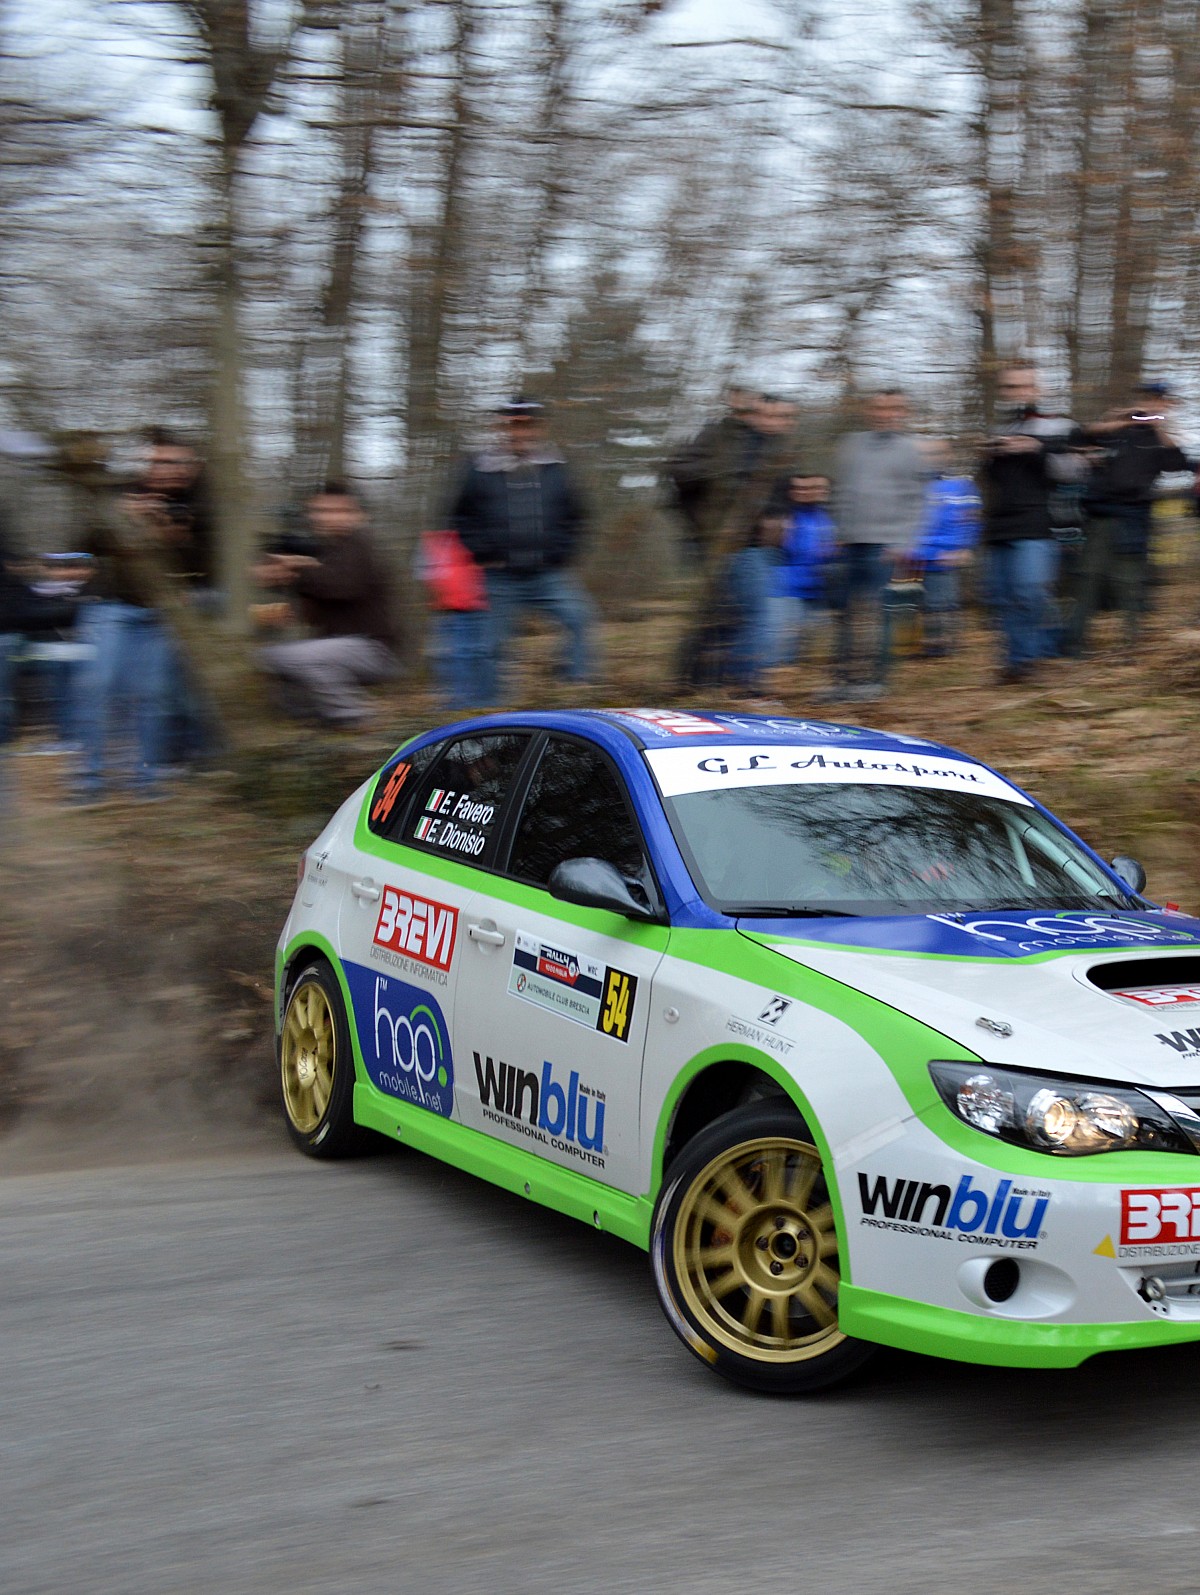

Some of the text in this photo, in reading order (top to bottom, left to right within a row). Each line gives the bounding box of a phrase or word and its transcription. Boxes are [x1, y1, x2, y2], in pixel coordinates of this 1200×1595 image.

[790, 755, 985, 784] Autosport
[371, 762, 412, 823] 54
[438, 790, 494, 825] E. Favero
[425, 818, 486, 856] E. Dionisio
[377, 889, 454, 966] BREVI
[370, 945, 448, 986] DISTRIBUZIONE INFORMATICA
[527, 982, 590, 1016] AUTOMOBILE CLUB BRESCIA
[602, 971, 630, 1038] 54
[726, 1020, 795, 1055] HERMAN HUNT
[473, 1050, 605, 1154] winblu
[482, 1108, 605, 1169] PROFESSIONAL COMPUTER
[857, 1172, 1050, 1239] winblu
[860, 1217, 1039, 1250] PROFESSIONAL COMPUTER
[1118, 1243, 1200, 1258] DISTRIBUZIONE
